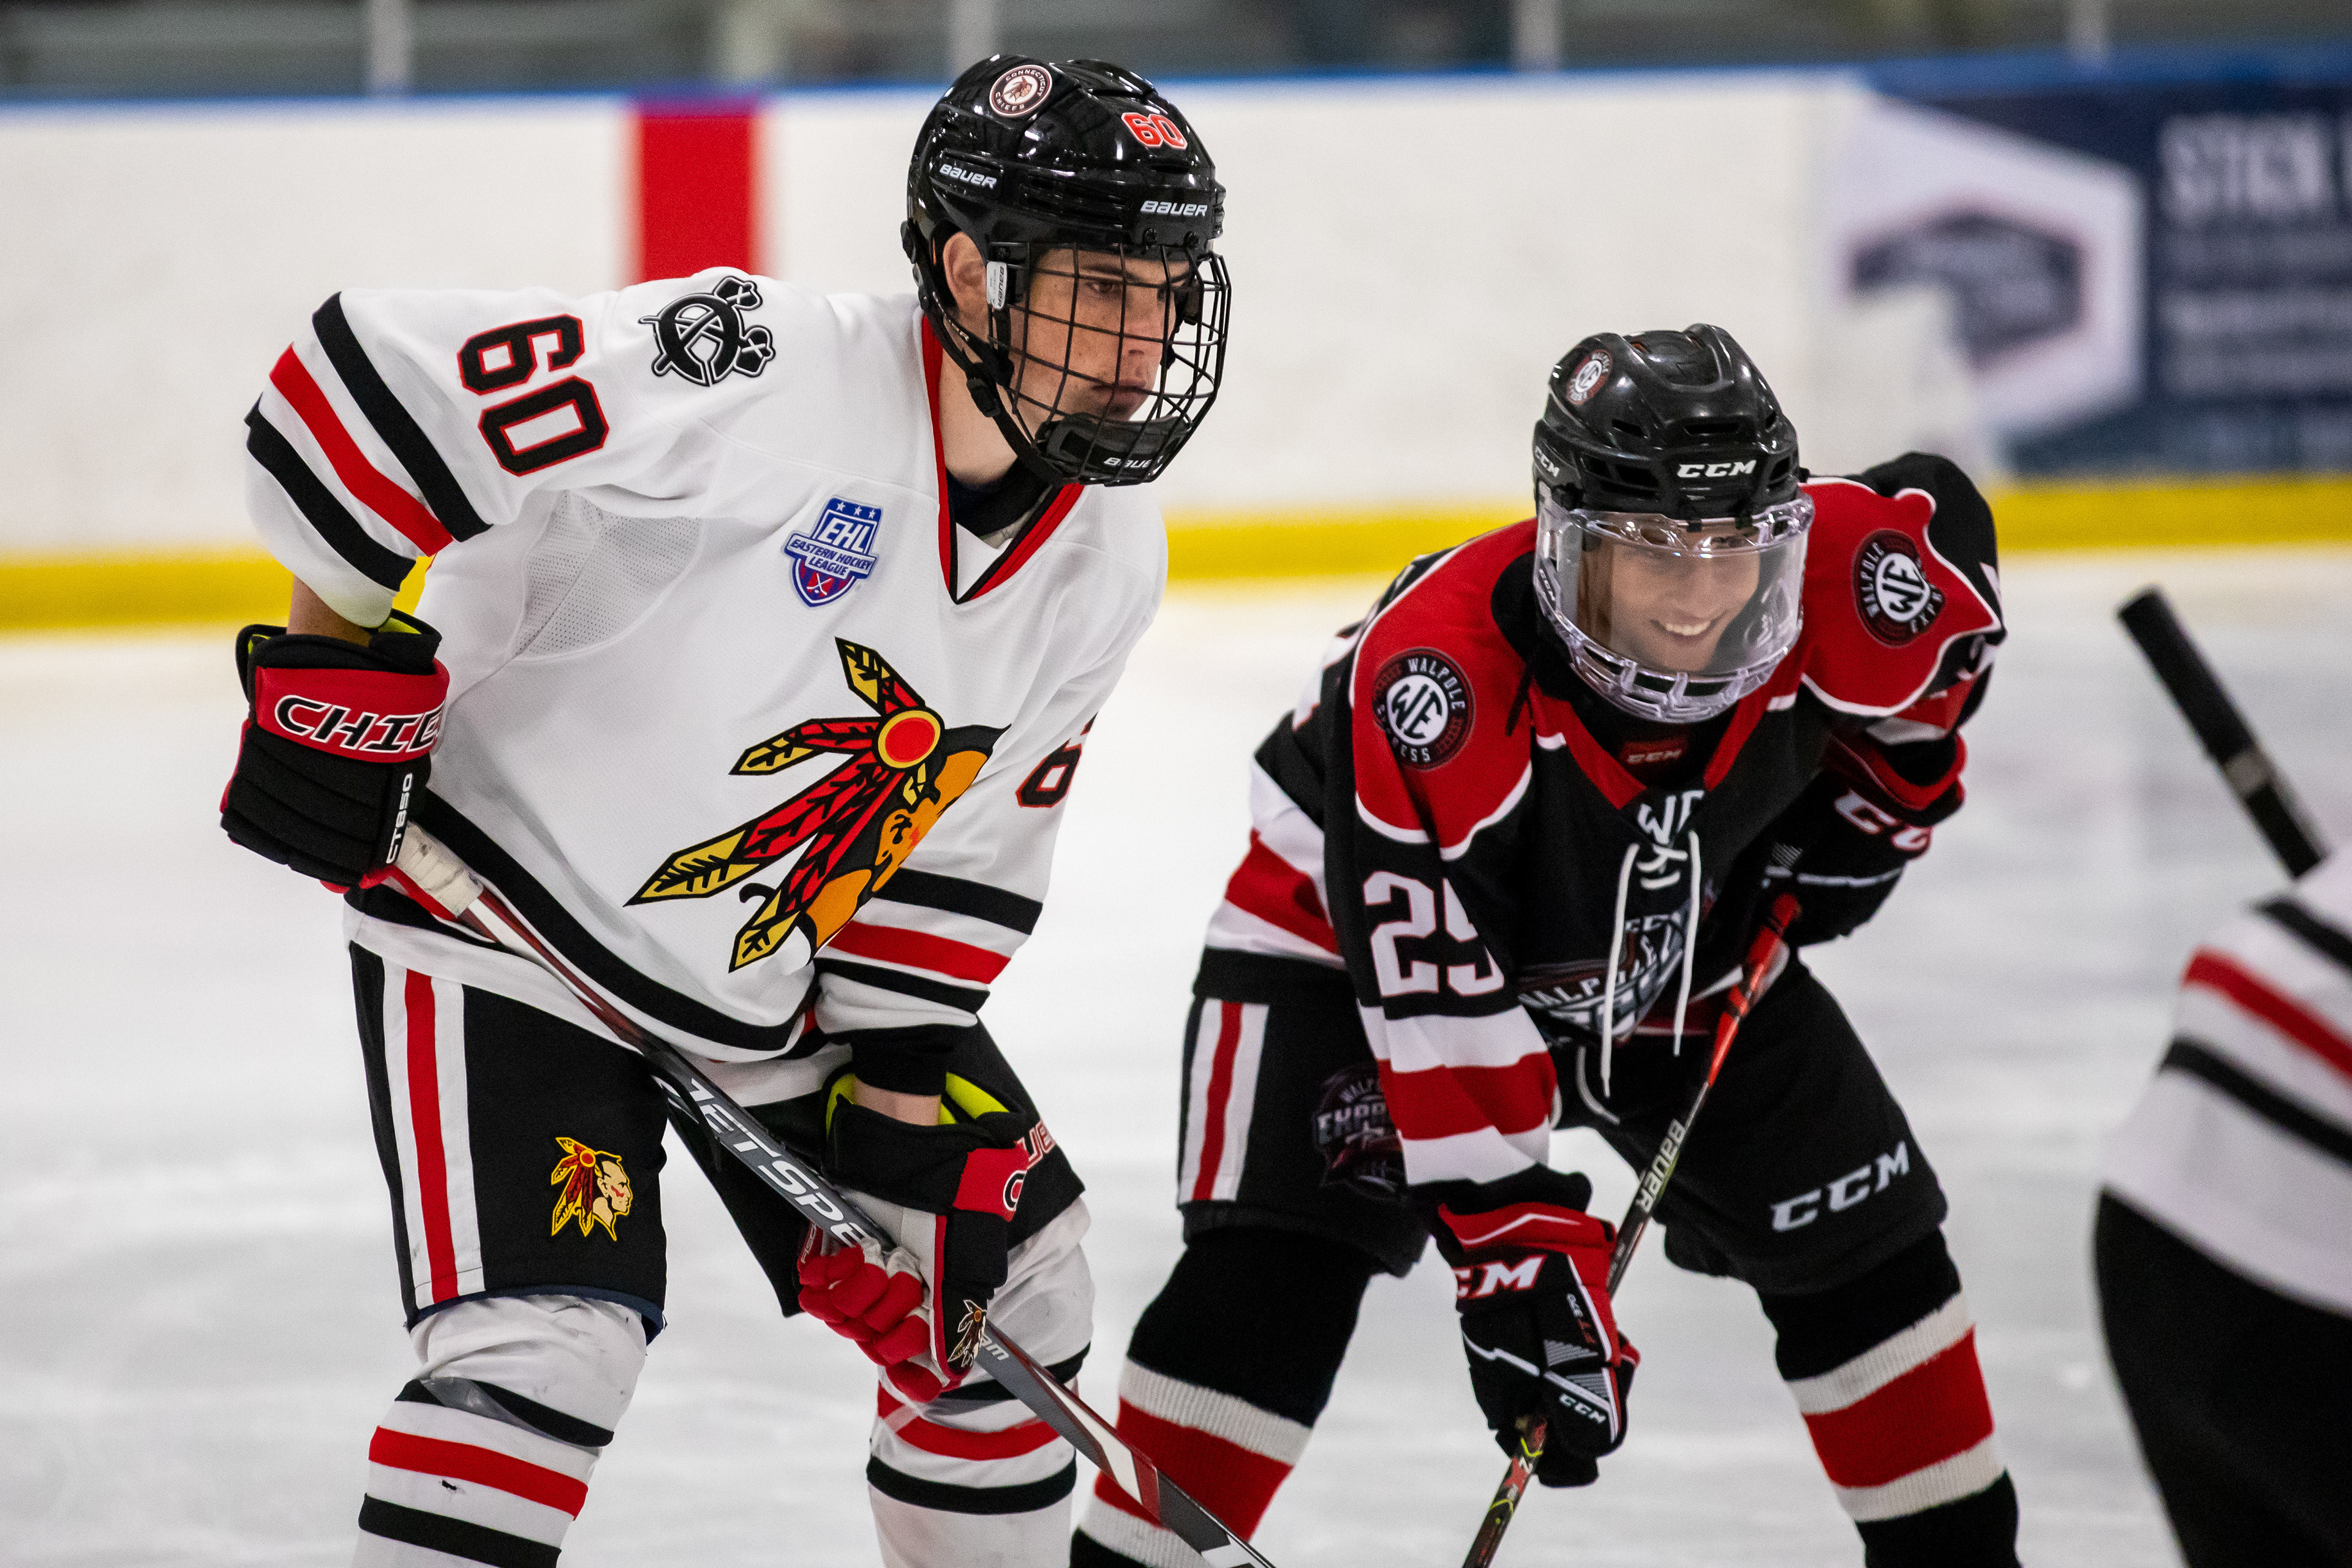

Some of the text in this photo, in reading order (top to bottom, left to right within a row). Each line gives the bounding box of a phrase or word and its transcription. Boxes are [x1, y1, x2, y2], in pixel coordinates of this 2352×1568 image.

[1005, 69, 1046, 97] CONNECTICUT
[995, 91, 1025, 111] CHIEFS
[1121, 112, 1188, 149] 60
[456, 313, 610, 477] 60
[1676, 459, 1757, 479] CCM
[816, 517, 871, 552] EHL
[790, 539, 875, 570] EASTERN HOCKEY
[808, 556, 849, 576] LEAGUE
[1407, 657, 1466, 710] WALPOLE
[1363, 870, 1505, 998] 25
[1770, 1140, 1910, 1232] CCM
[1558, 1392, 1607, 1424] CCM
